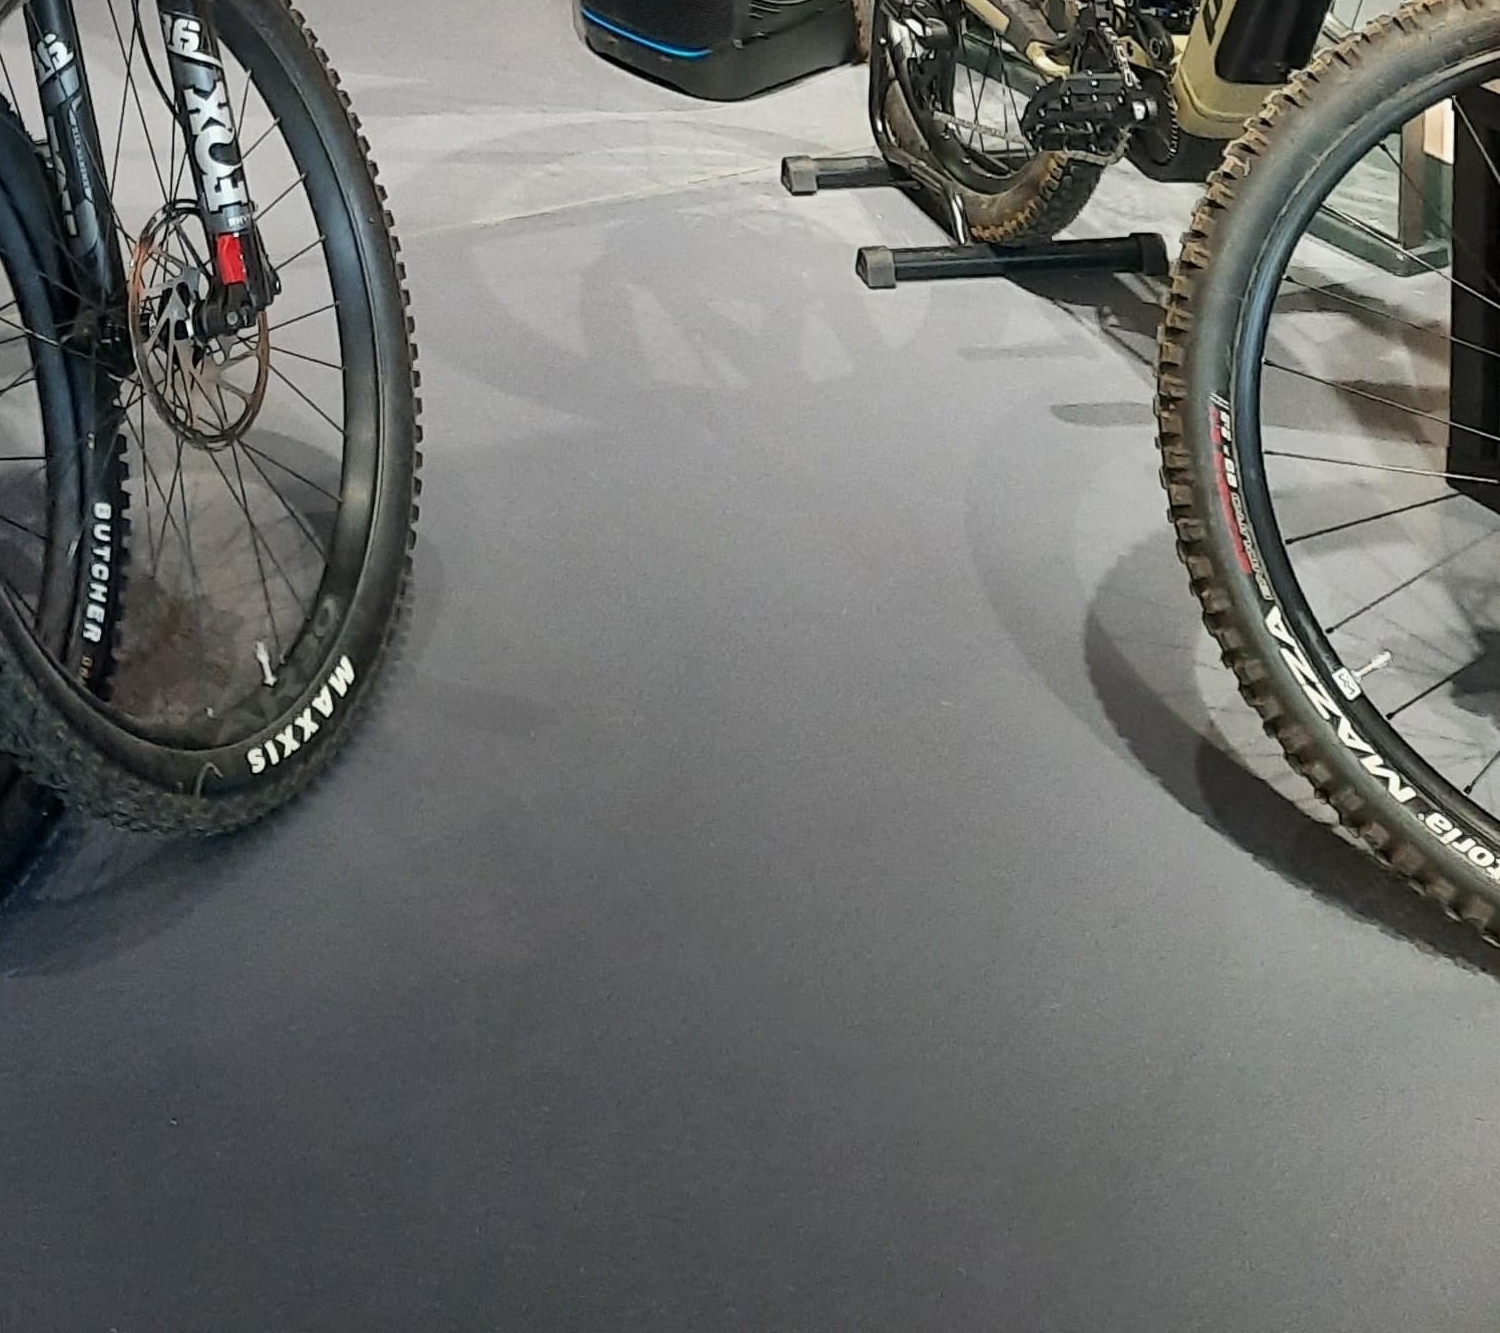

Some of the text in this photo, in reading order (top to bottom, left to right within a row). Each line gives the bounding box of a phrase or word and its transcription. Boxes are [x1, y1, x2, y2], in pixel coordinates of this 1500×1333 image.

[183, 80, 249, 212] FOX
[82, 501, 113, 644] BUTCHER
[245, 653, 356, 775] MAXXIS
[1264, 605, 1417, 804] MAZZA
